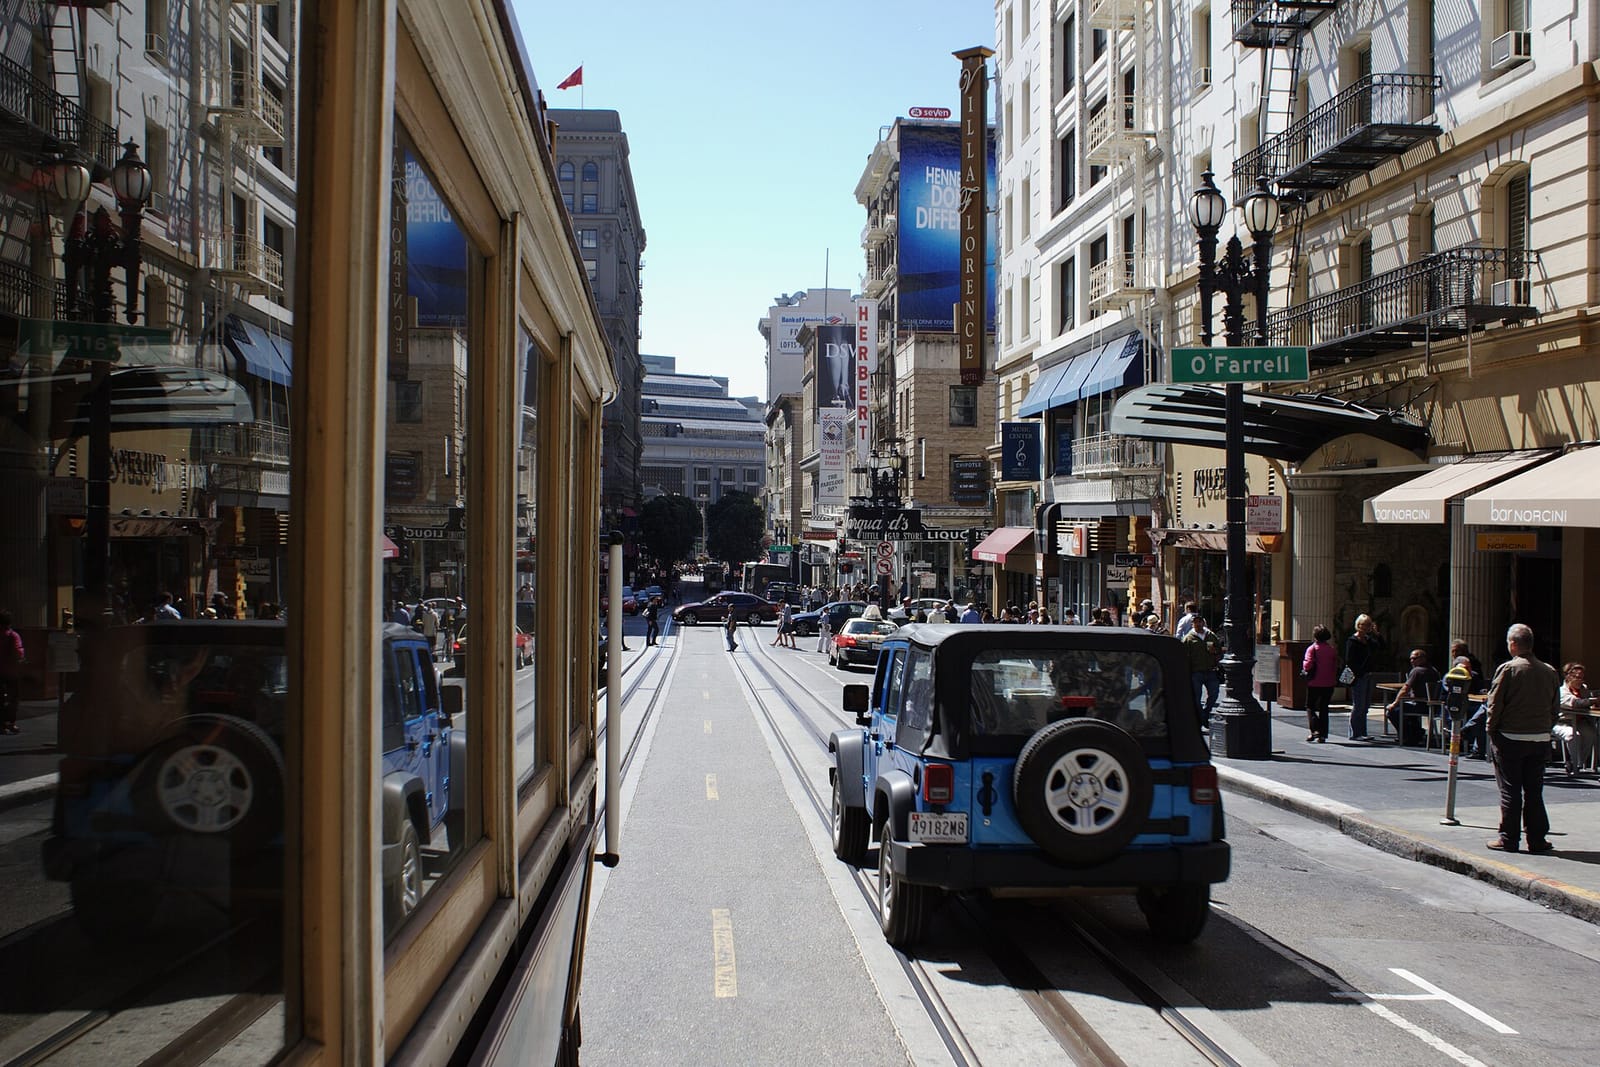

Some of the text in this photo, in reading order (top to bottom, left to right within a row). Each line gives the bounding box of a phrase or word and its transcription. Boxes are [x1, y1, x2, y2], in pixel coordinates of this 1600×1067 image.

[923, 109, 949, 117] seven
[958, 63, 984, 360] VILLA FLORENCE
[858, 306, 868, 440] HERBERT
[1191, 354, 1290, 375] O'Farrell
[1490, 498, 1512, 521] bar
[844, 511, 909, 539] Marquad's
